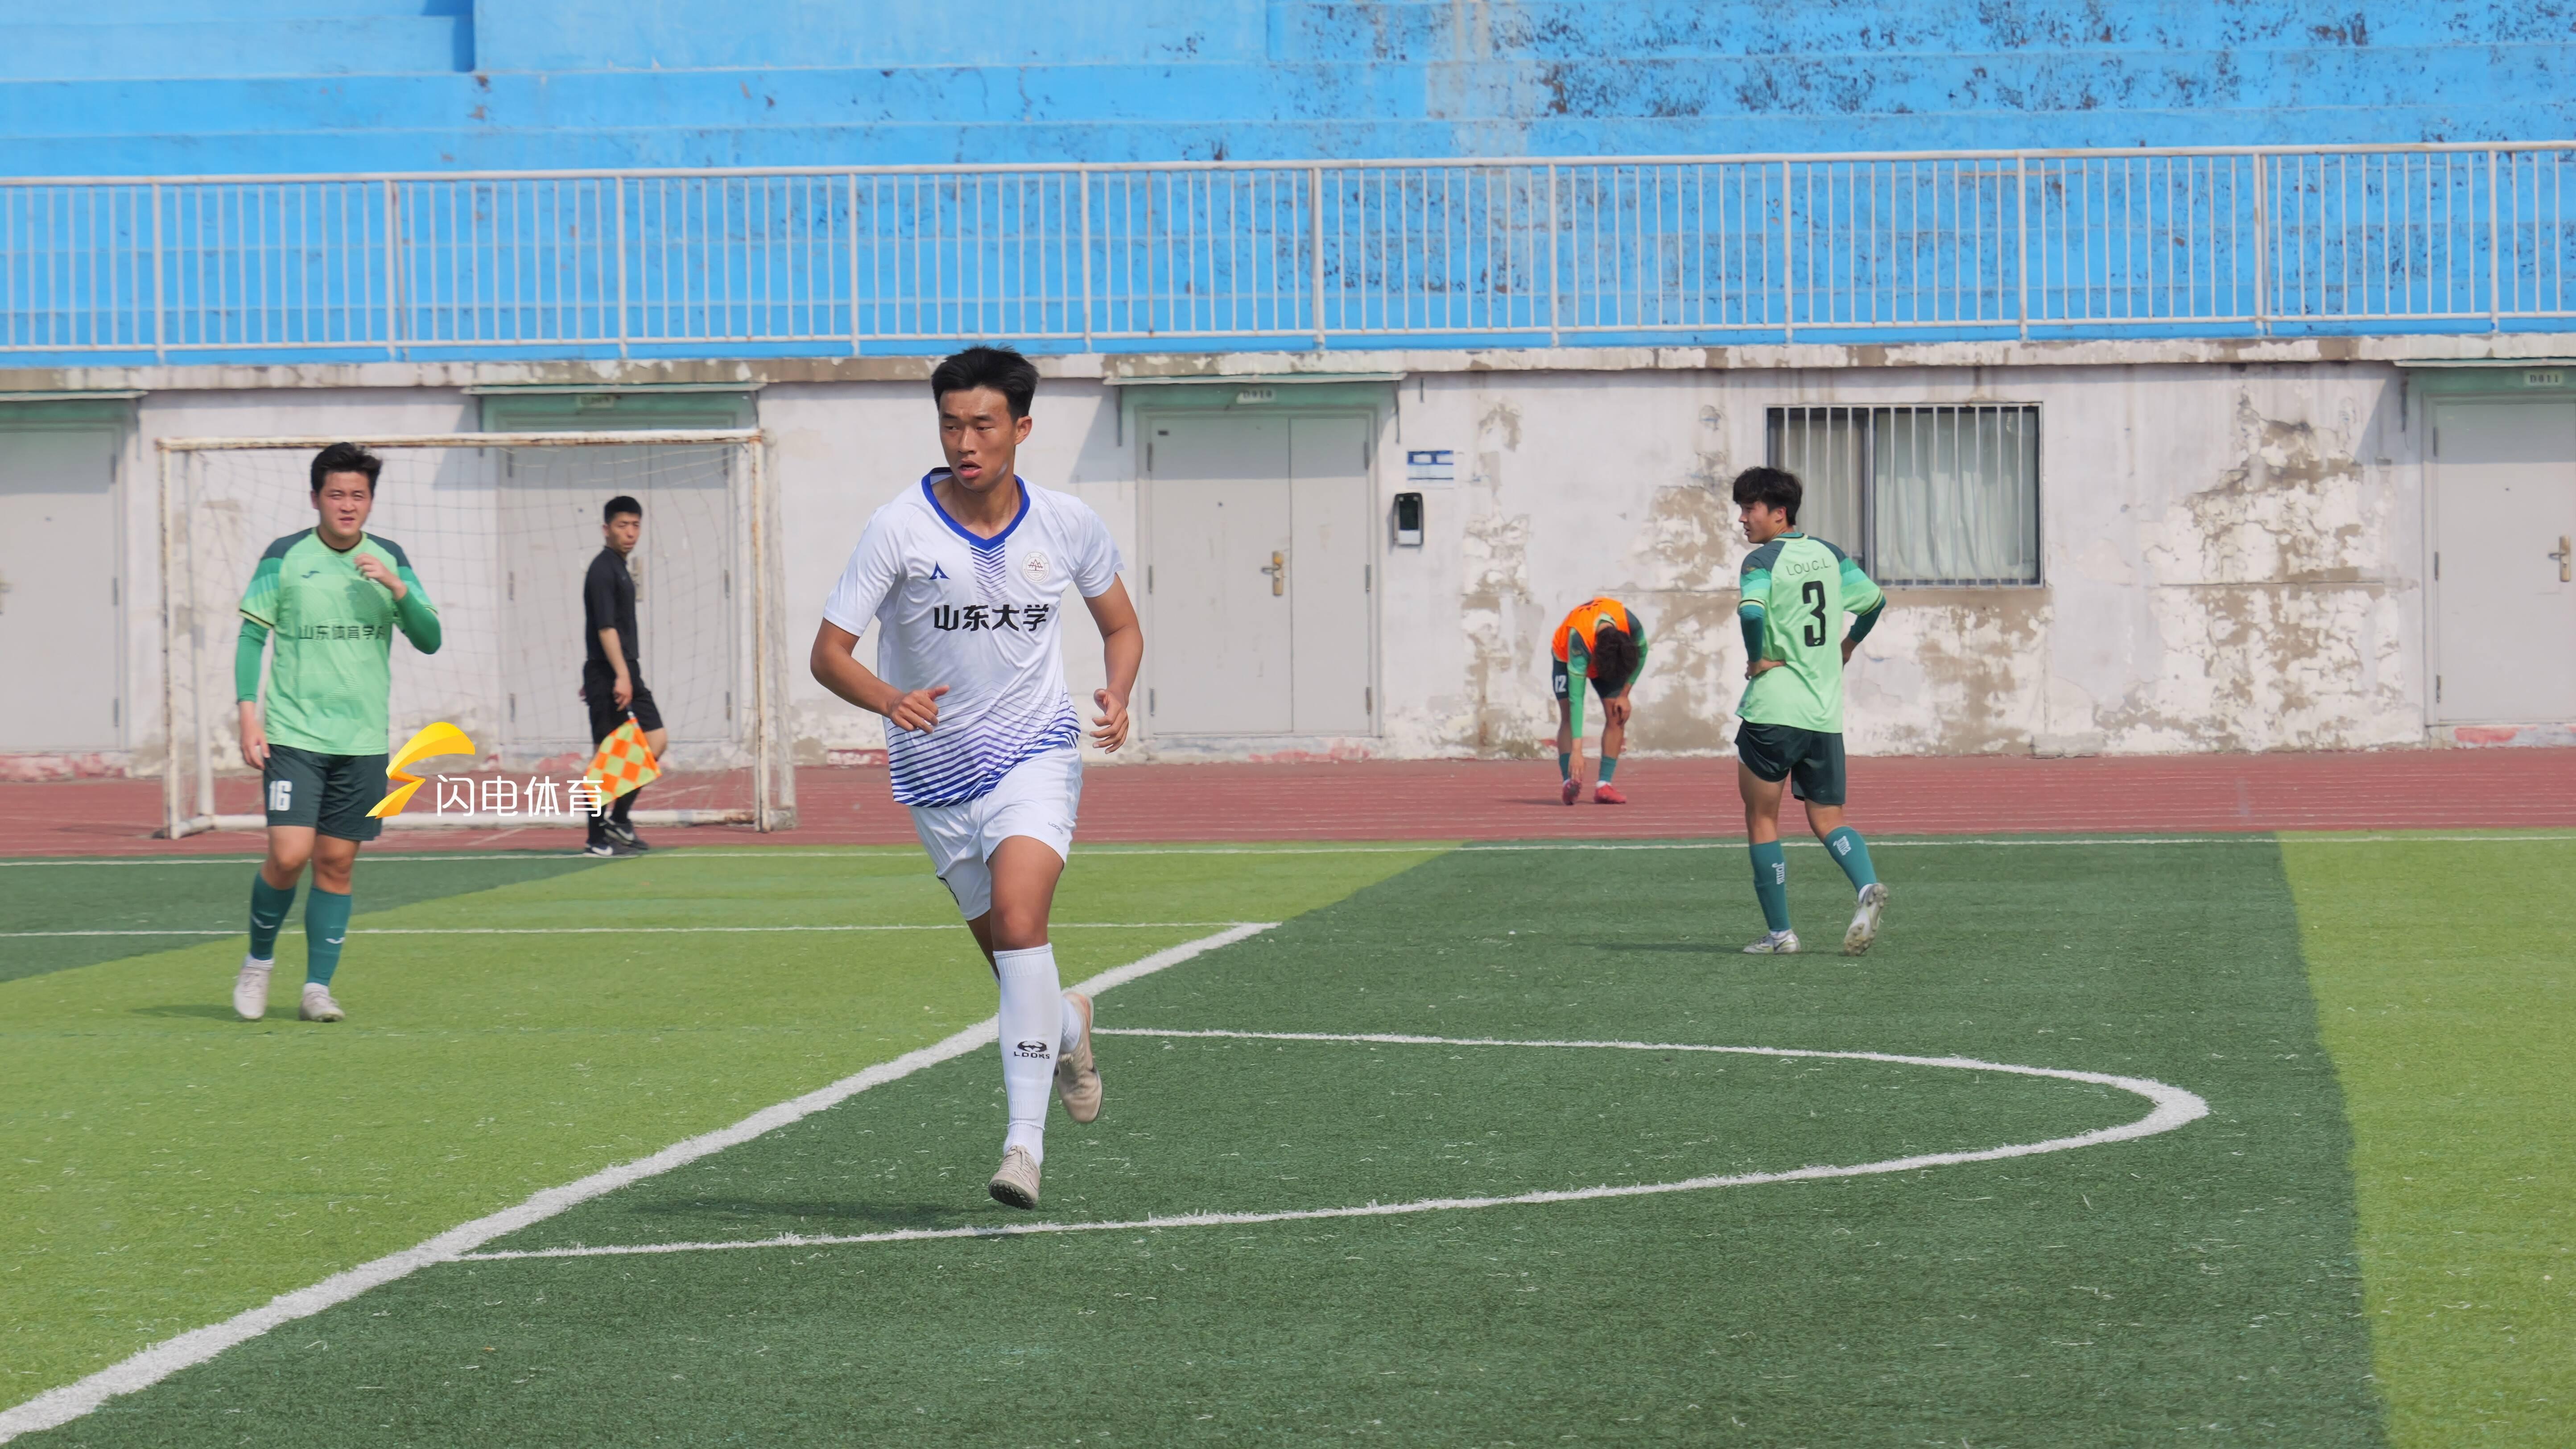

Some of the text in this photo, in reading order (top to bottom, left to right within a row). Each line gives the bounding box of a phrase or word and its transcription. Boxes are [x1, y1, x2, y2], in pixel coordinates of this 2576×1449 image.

[934, 604, 1049, 632] 山东大学
[1802, 580, 1826, 647] 3
[1555, 675, 1567, 692] 12
[268, 780, 293, 811] 16
[1771, 861, 1785, 885] Joma
[1014, 1051, 1050, 1059] LOOKS
